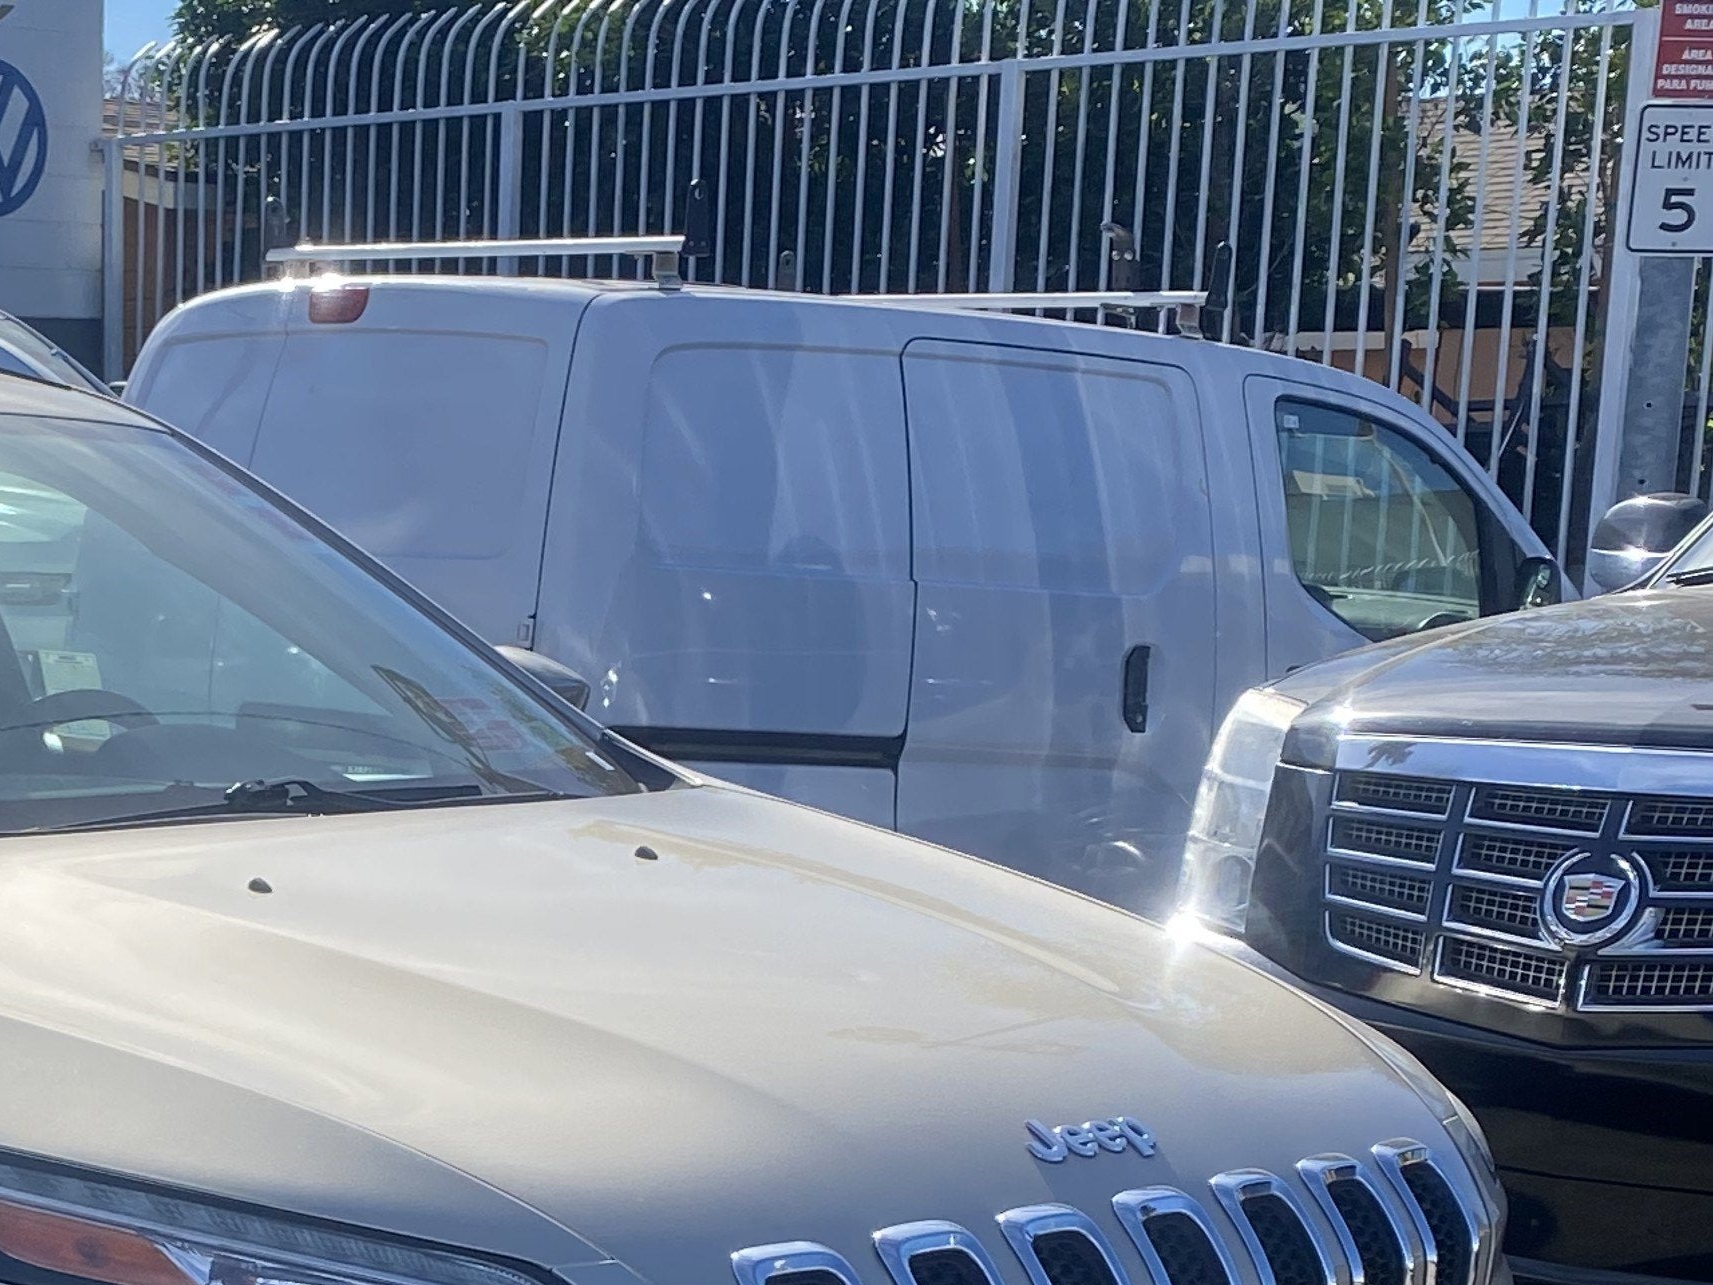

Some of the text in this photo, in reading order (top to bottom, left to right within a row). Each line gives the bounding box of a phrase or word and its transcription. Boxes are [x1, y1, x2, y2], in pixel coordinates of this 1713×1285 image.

[1657, 78, 1687, 90] PARA
[1650, 150, 1713, 170] LIMIT
[1658, 187, 1696, 233] 5
[1024, 1116, 1157, 1162] Jeep
